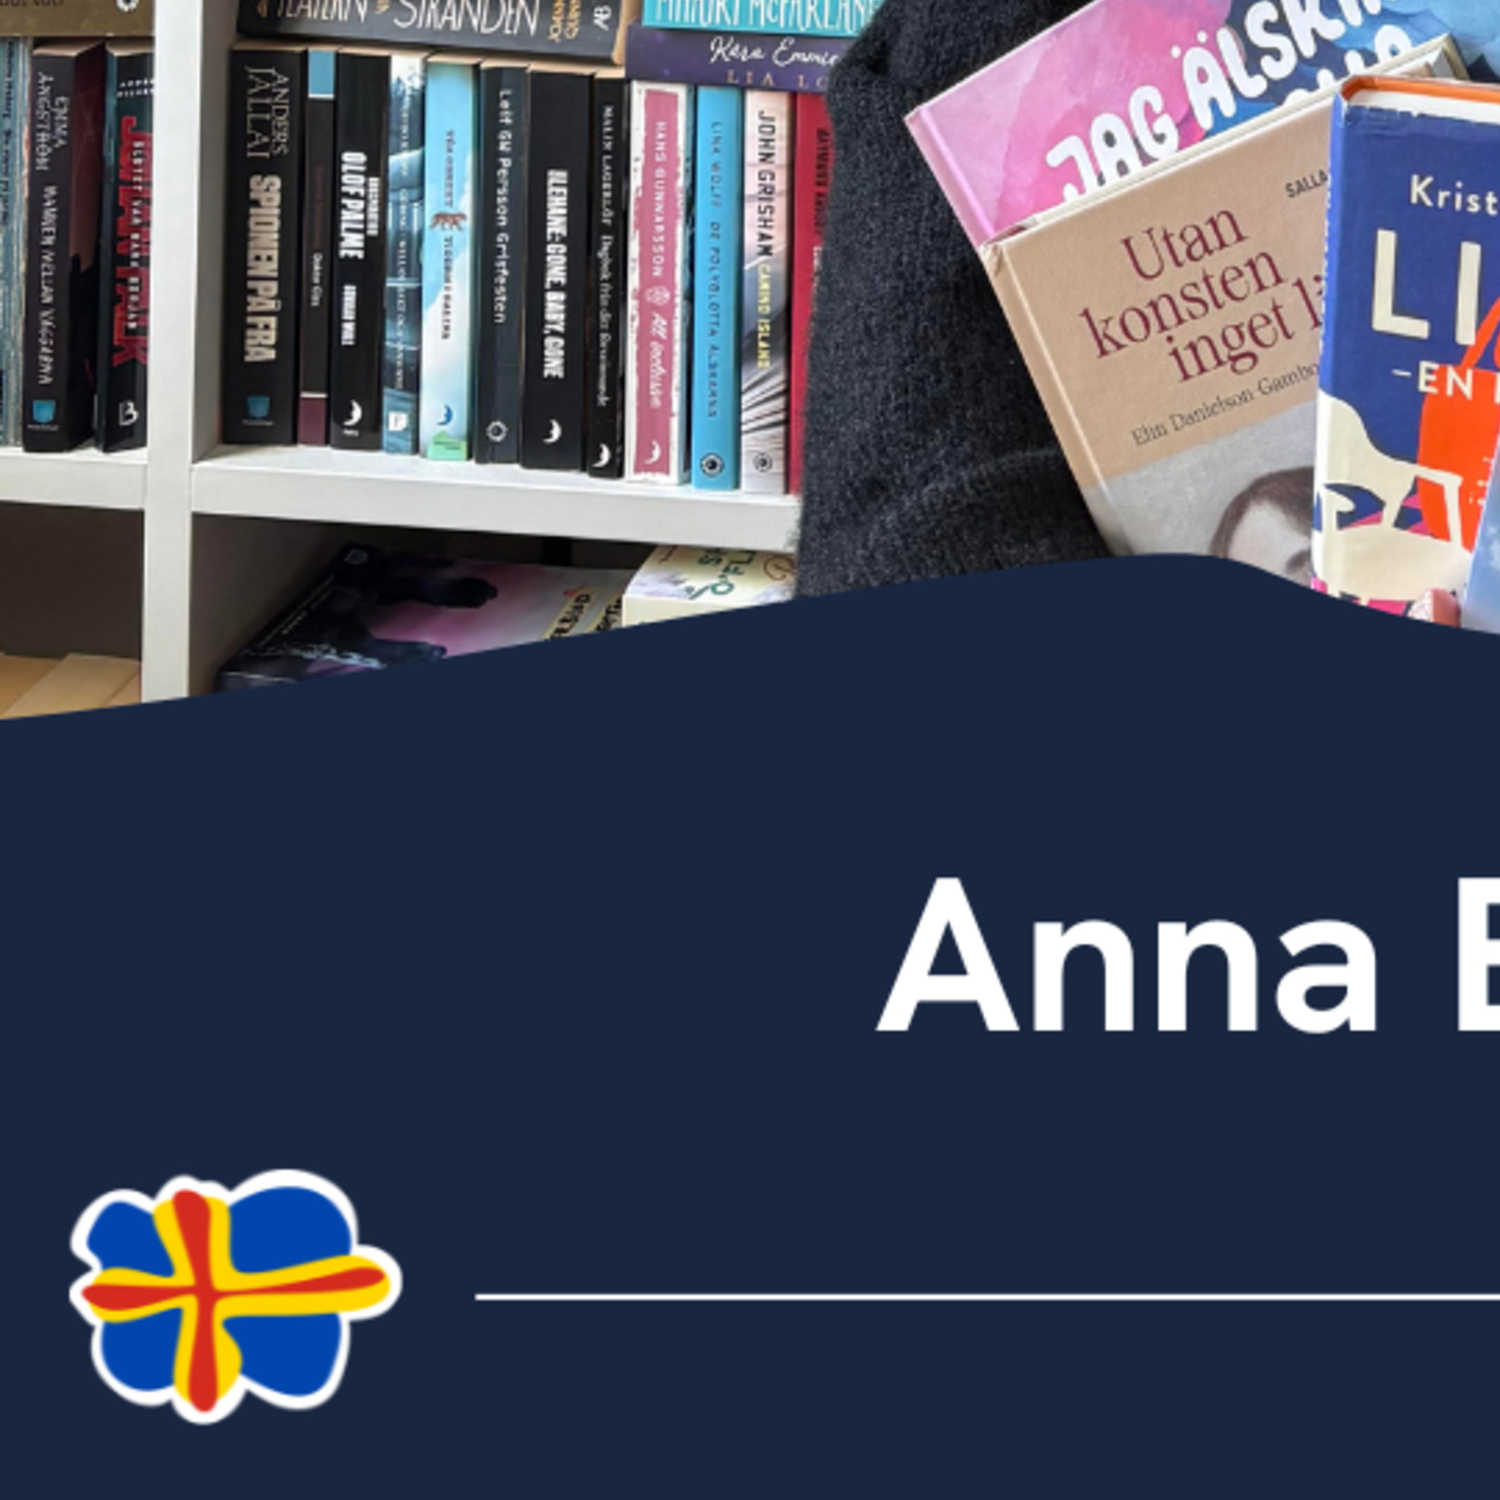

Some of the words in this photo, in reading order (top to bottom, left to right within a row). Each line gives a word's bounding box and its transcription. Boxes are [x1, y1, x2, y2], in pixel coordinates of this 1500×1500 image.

[653, 120, 668, 163] HANS
[757, 110, 776, 163] JOHN
[1046, 85, 1181, 204] JAG
[340, 150, 368, 196] OLOF
[495, 156, 511, 226] Persson
[246, 173, 282, 277] SPIONEN
[338, 197, 366, 259] PALME
[756, 168, 775, 258] GRISHAM
[1121, 207, 1250, 282] Utan
[246, 279, 283, 312] PÅ
[492, 231, 510, 323] Grisfesten
[1079, 248, 1289, 359] konsten
[244, 314, 278, 362] FRA
[542, 336, 566, 379] GONE
[1167, 293, 1296, 384] inget
[1130, 422, 1168, 447] Elin
